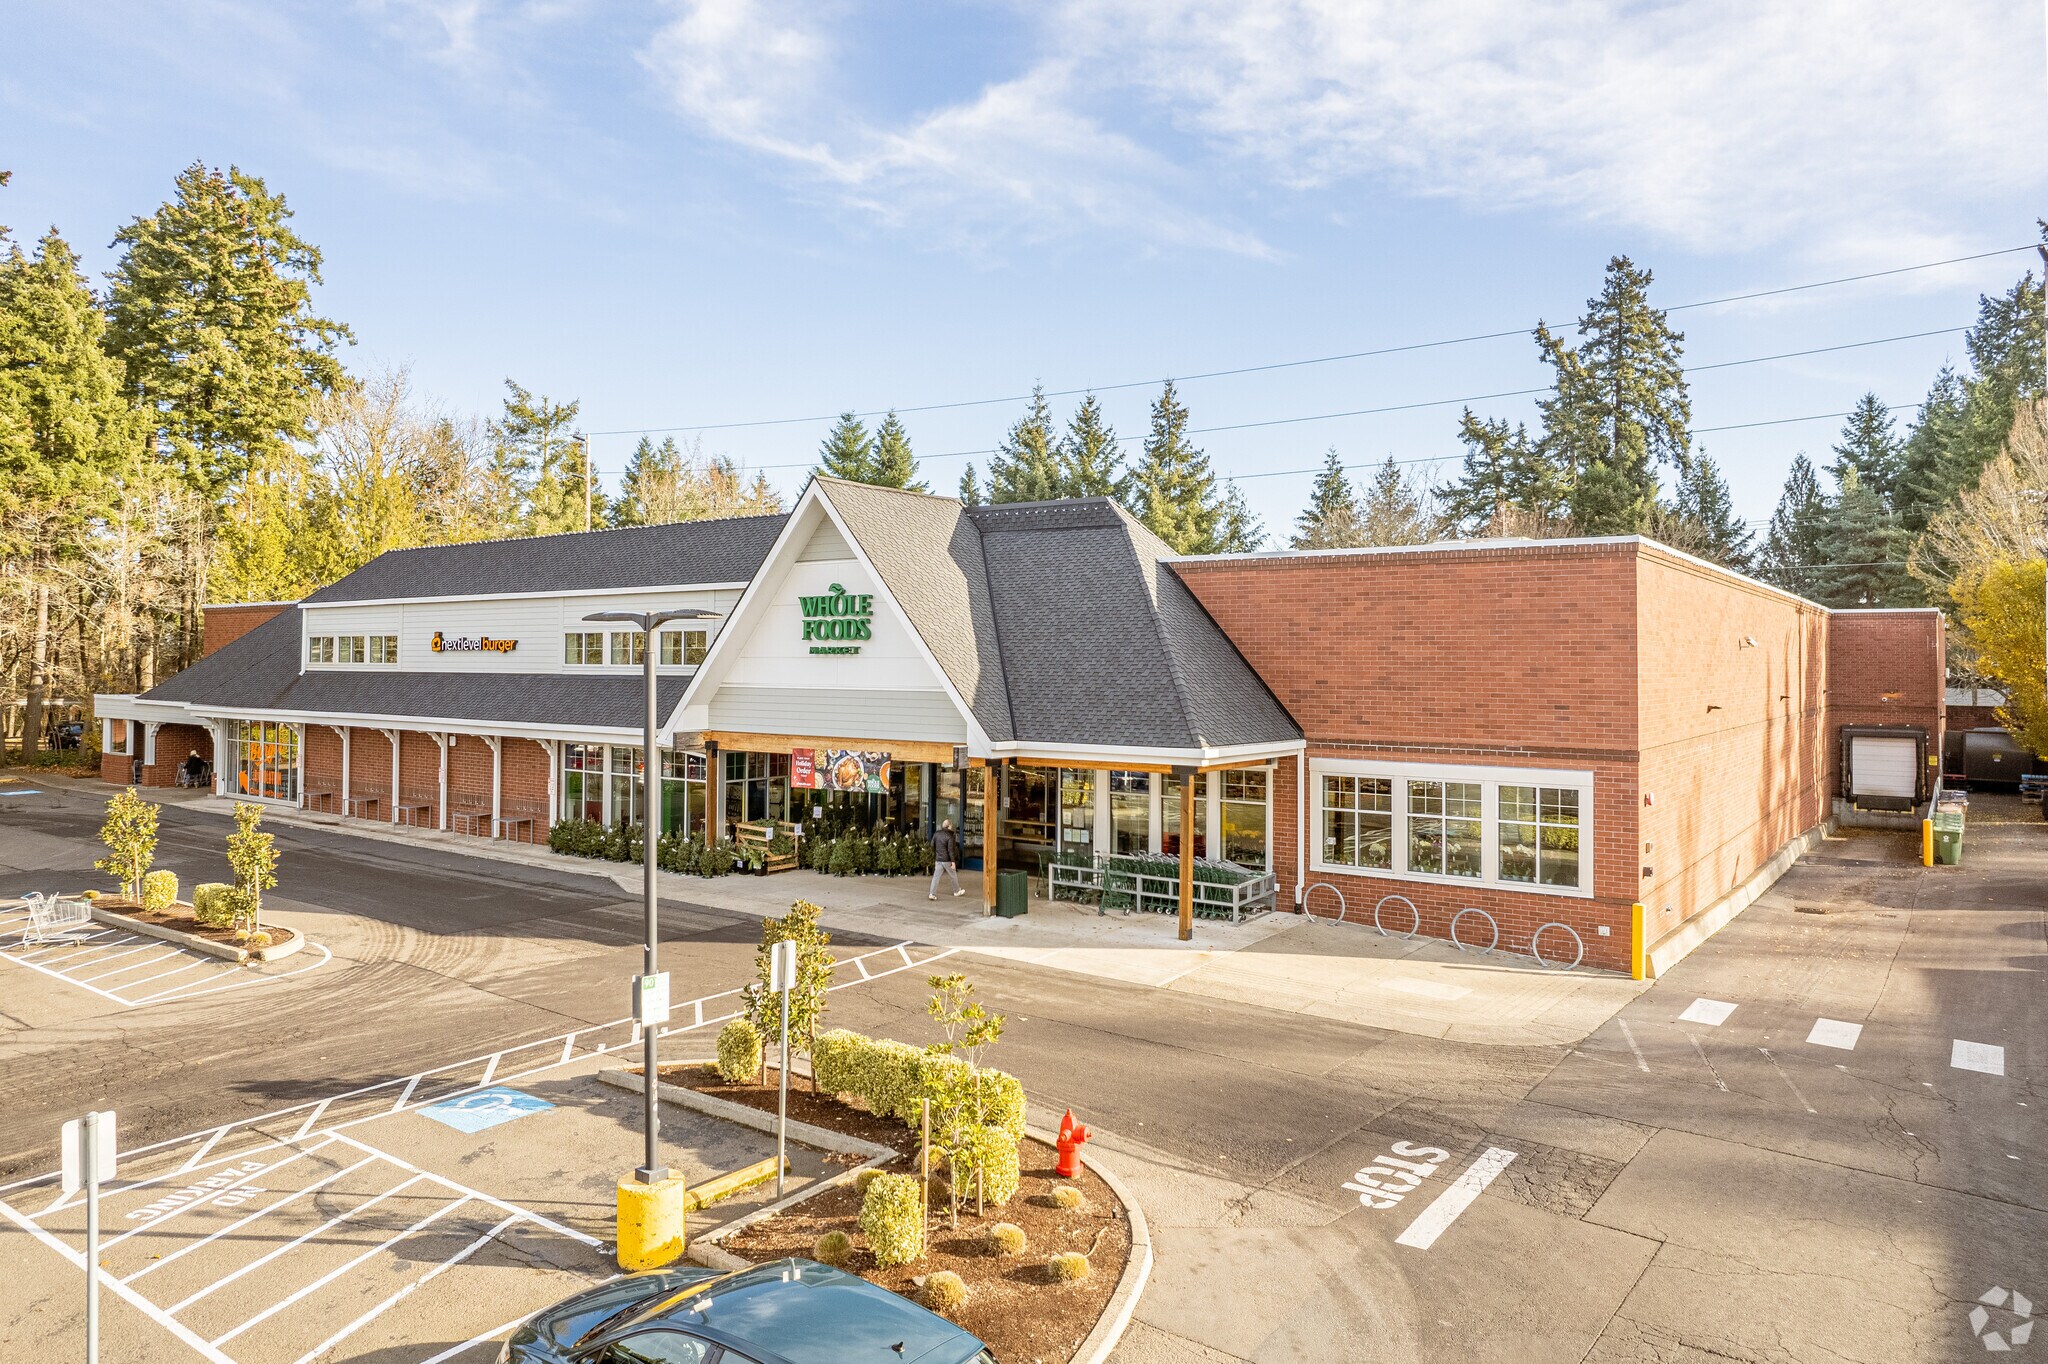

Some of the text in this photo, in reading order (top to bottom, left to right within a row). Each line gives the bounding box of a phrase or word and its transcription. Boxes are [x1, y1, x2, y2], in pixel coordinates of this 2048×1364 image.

[798, 594, 874, 617] WHOLE
[802, 618, 871, 641] FOODS
[809, 646, 861, 654] MARKET
[645, 978, 654, 988] 90
[1341, 1140, 1450, 1209] STOP
[125, 1161, 268, 1221] PARKING
[211, 1184, 267, 1207] NO
